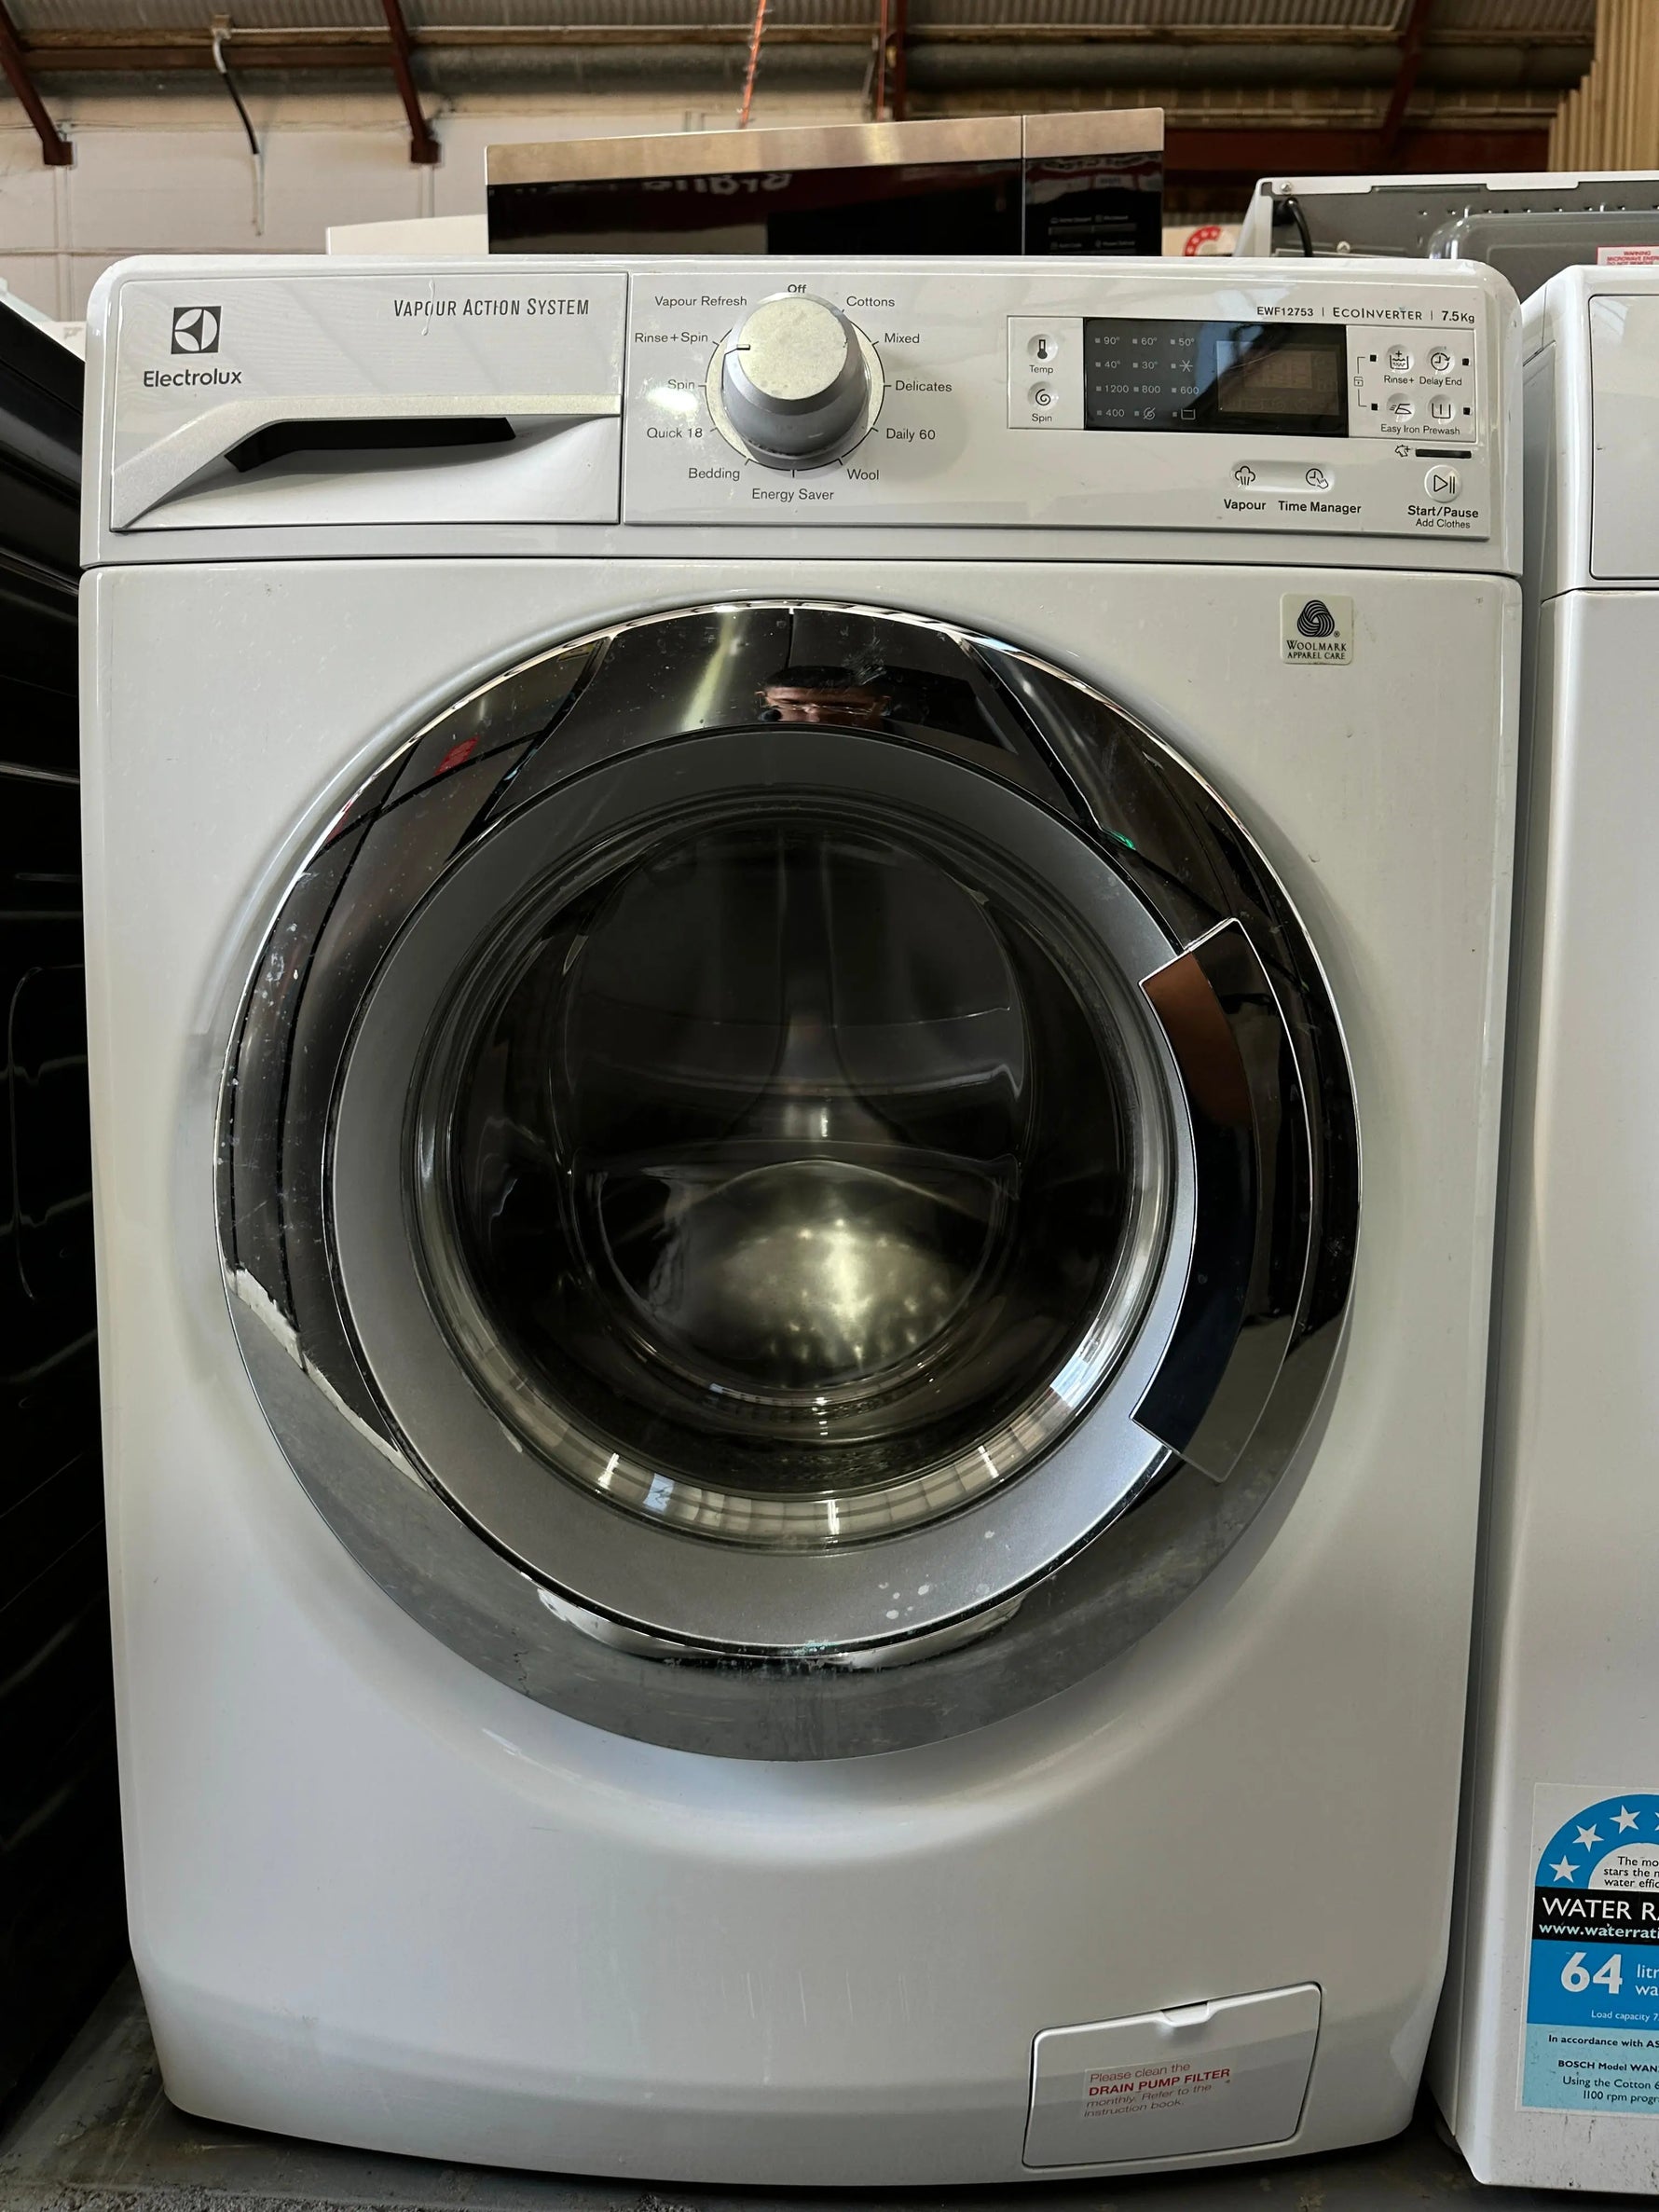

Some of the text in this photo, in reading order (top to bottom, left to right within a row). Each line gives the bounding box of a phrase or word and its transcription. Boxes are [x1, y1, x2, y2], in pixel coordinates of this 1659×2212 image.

[787, 284, 806, 294] Off
[655, 295, 747, 307] Vapour Refresh
[846, 296, 895, 307] Cottons
[394, 298, 589, 317] VAPOUR ACTION SYSTEM
[1256, 307, 1314, 317] EWF12753
[884, 334, 920, 343] Mixed
[1029, 364, 1054, 377] Temp
[143, 370, 242, 388] Electrolux
[667, 379, 695, 390] Spin
[1419, 377, 1462, 388] Delay End
[896, 380, 953, 392] Delicates
[1105, 385, 1129, 393] 1200
[1142, 385, 1160, 393] 800
[1180, 386, 1199, 394] 600
[1032, 413, 1052, 424] Spin
[647, 427, 703, 438] Quick 18
[886, 429, 936, 441] Daily 60
[1380, 424, 1420, 435] Easy Iron
[1422, 425, 1460, 435] Prewash
[689, 468, 740, 481] Bedding
[847, 469, 879, 479] Wool
[752, 488, 834, 502] Energy Saver
[1224, 500, 1266, 513] Vapour
[1278, 501, 1361, 515] Time Manager
[1407, 504, 1479, 520] Start/Pause
[1416, 518, 1471, 529] Add Clothes
[1618, 1856, 1638, 1865] The
[1633, 1868, 1650, 1876] the
[1542, 1897, 1632, 1920] WATER
[1560, 1952, 1623, 1994] 64
[1591, 2010, 1612, 2018] Load
[1615, 2013, 1650, 2022] capacity
[1561, 2037, 1618, 2046] accordance
[1558, 2060, 1595, 2068] BOSCH
[1090, 2063, 1190, 2082] Please clean the
[1089, 2068, 1230, 2096] DRAIN PUMP FILTER
[1563, 2076, 1590, 2088] Using
[1595, 2079, 1610, 2087] the
[1614, 2080, 1651, 2089] Cotton
[1142, 2090, 1172, 2100] Refer
[1194, 2084, 1212, 2093] the
[1584, 2091, 1603, 2099] 1100
[1084, 2098, 1185, 2118] instruction book.
